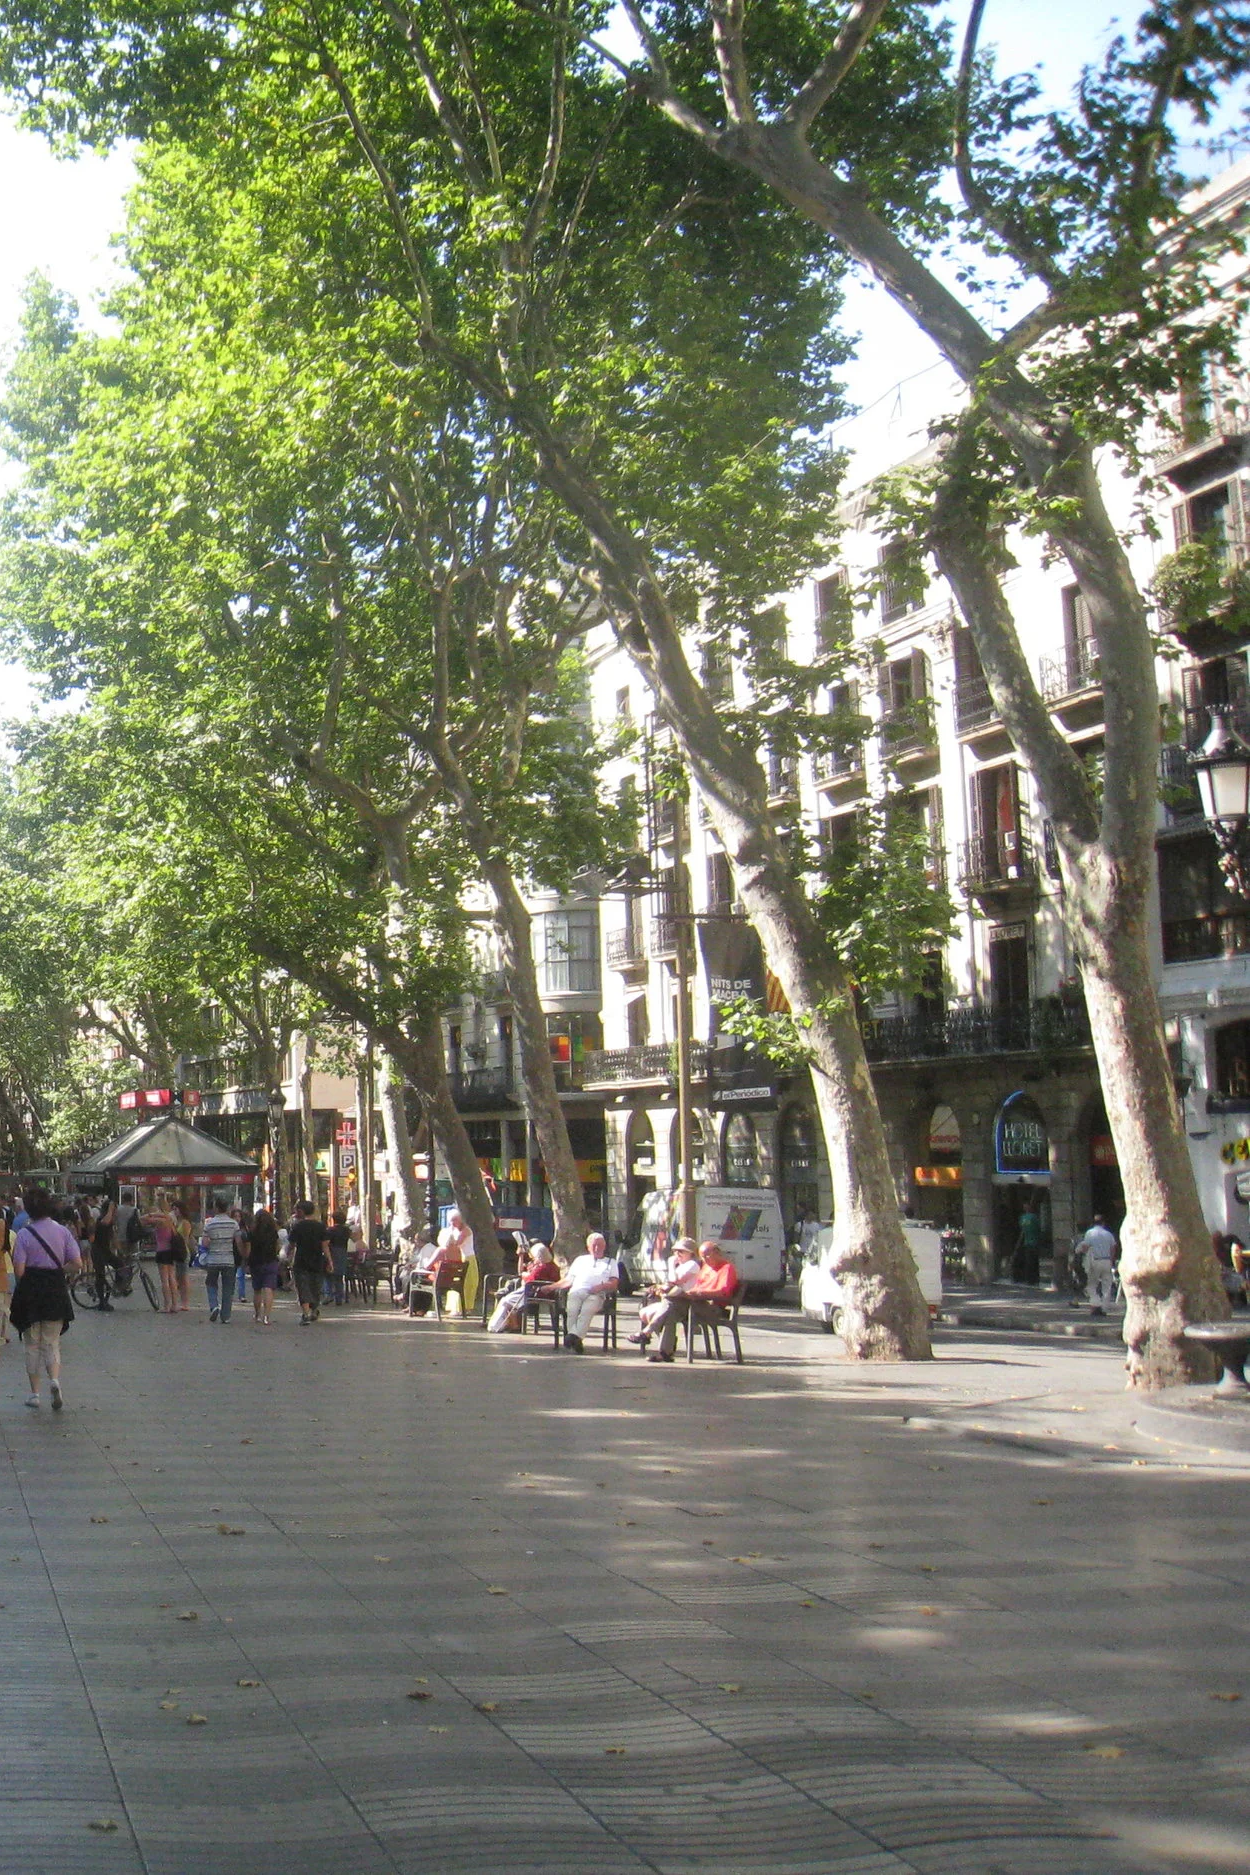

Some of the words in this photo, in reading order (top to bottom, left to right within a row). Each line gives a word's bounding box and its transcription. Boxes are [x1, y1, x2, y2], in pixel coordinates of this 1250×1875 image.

[710, 978, 731, 990] NITS
[734, 979, 752, 990] DE
[1004, 1122, 1043, 1139] HOTEL
[343, 1155, 353, 1168] P
